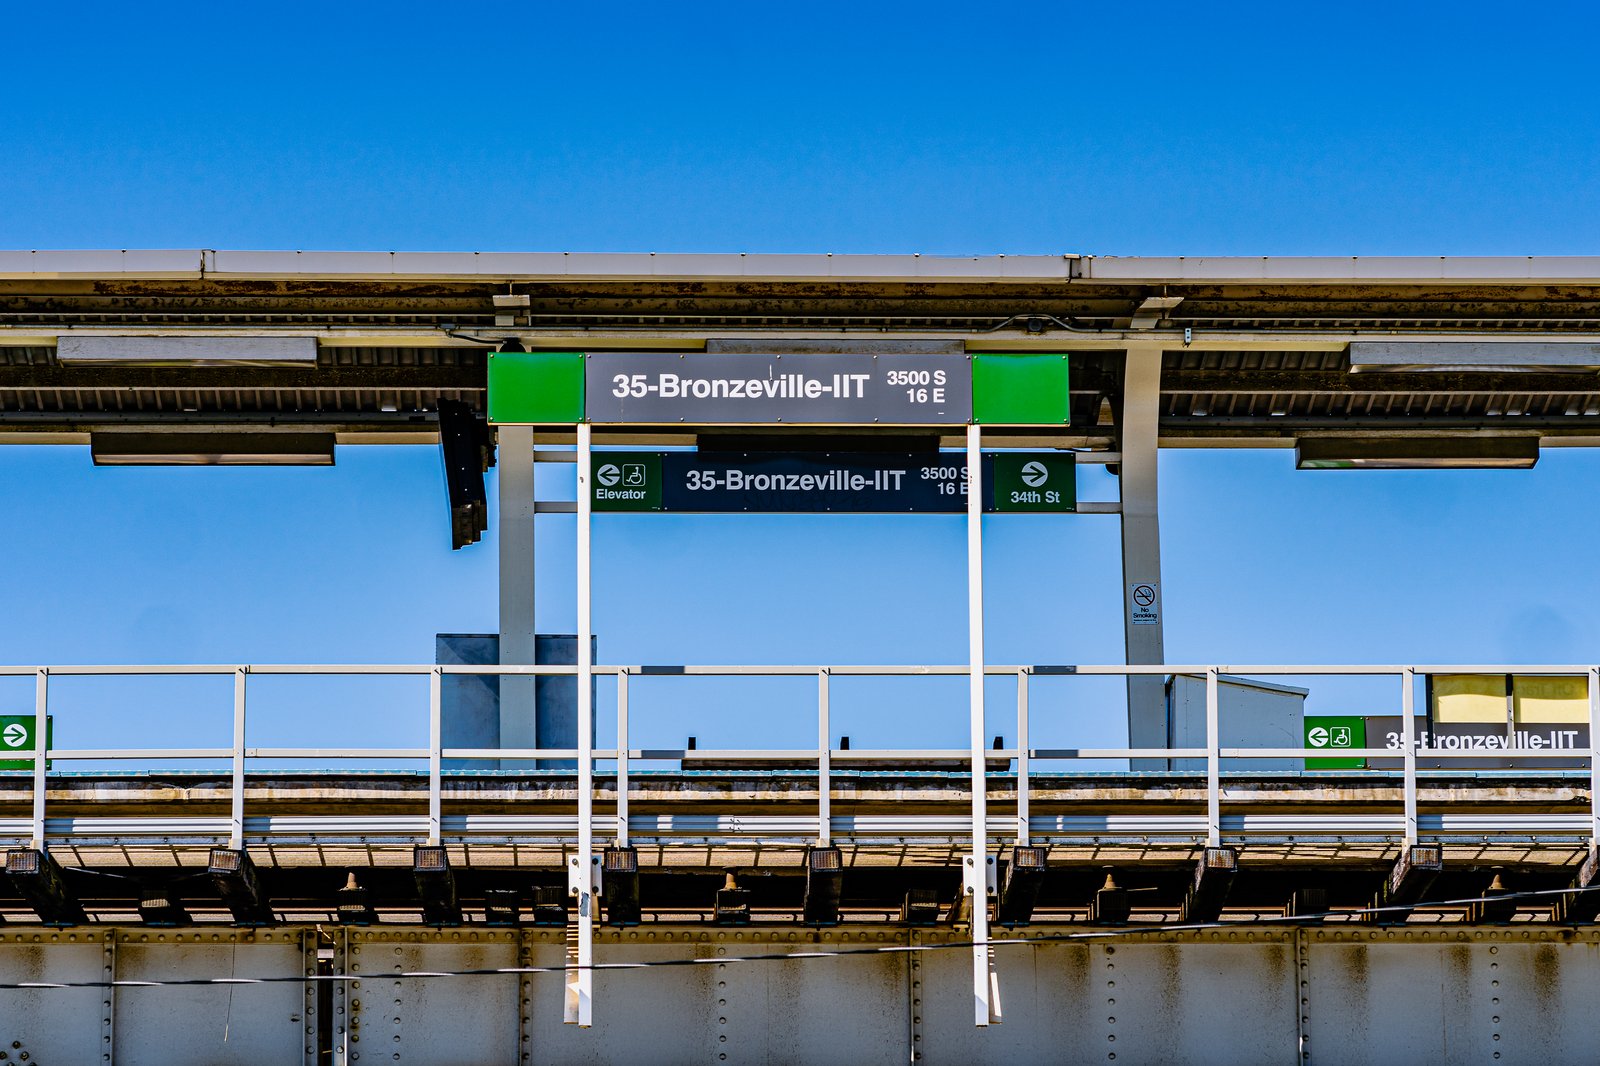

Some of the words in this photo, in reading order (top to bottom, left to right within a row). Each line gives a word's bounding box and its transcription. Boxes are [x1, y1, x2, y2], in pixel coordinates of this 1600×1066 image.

[886, 370, 930, 386] 3500
[933, 370, 947, 386] S
[612, 373, 870, 398] 35-Bronzeville-IIT
[906, 388, 928, 403] 16
[933, 388, 945, 403] E
[685, 469, 906, 491] 35-Bronzeville-IIT
[920, 466, 957, 480] 3500
[596, 488, 646, 500] Elevator
[937, 482, 956, 495] 16
[1010, 490, 1041, 503] 34th
[1045, 490, 1060, 503] St
